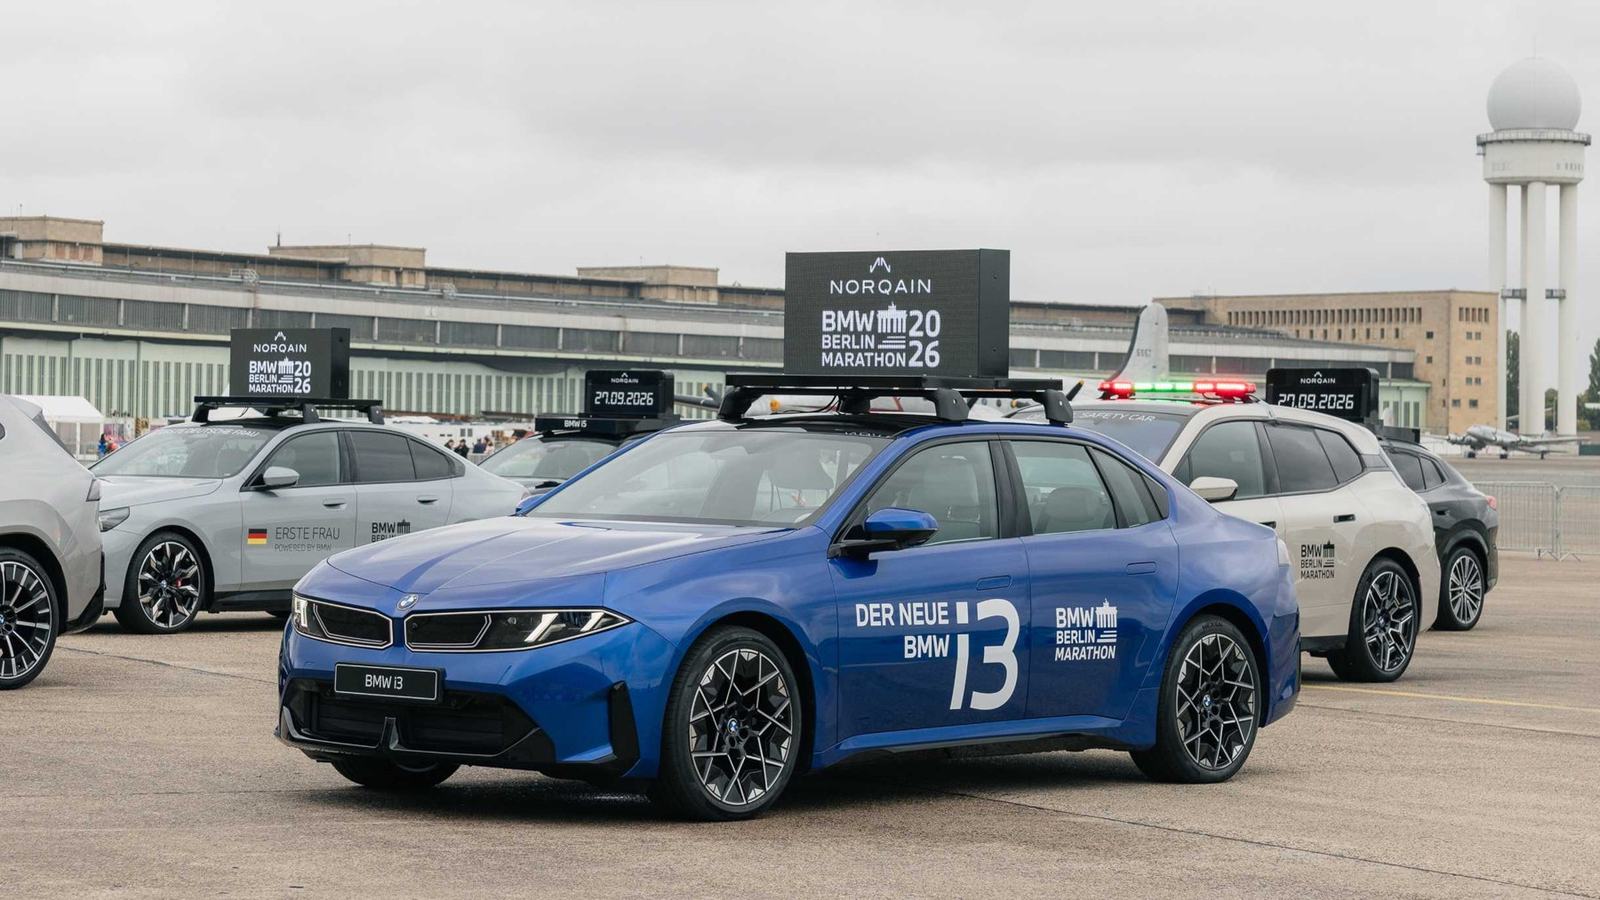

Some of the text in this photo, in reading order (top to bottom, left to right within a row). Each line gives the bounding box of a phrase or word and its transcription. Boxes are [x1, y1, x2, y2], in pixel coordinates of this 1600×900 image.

[830, 279, 931, 295] NORQAIN
[822, 310, 875, 332] BMW
[908, 310, 941, 337] 20
[253, 344, 307, 353] NORQAIN
[821, 334, 875, 350] BERLIN
[821, 352, 906, 368] MARATHON
[908, 340, 940, 368] 26
[249, 360, 278, 374] BMW
[294, 361, 312, 377] 20
[249, 374, 278, 383] BERLIN
[294, 378, 311, 394] 26
[1300, 377, 1336, 385] NORQAIN
[249, 384, 293, 393] MARATHON
[594, 391, 654, 406] 27.09.2026
[1278, 393, 1354, 409] 27.09.2026
[564, 420, 580, 428] BMW
[1080, 412, 1157, 422] SAFETY CAR
[275, 527, 341, 540] ERSTE FRAU
[371, 522, 396, 534] BMW
[274, 543, 333, 552] POWERED BY BMW
[1301, 544, 1322, 558] BMW
[1301, 559, 1323, 569] BERLIN
[1301, 570, 1335, 579] MARATHON
[855, 602, 949, 627] DER NEUE
[1055, 607, 1094, 628] BMW
[1056, 630, 1096, 644] BERLIN
[904, 634, 950, 659] BMW
[1054, 645, 1117, 662] MARATHON
[365, 674, 404, 690] BMW i3
